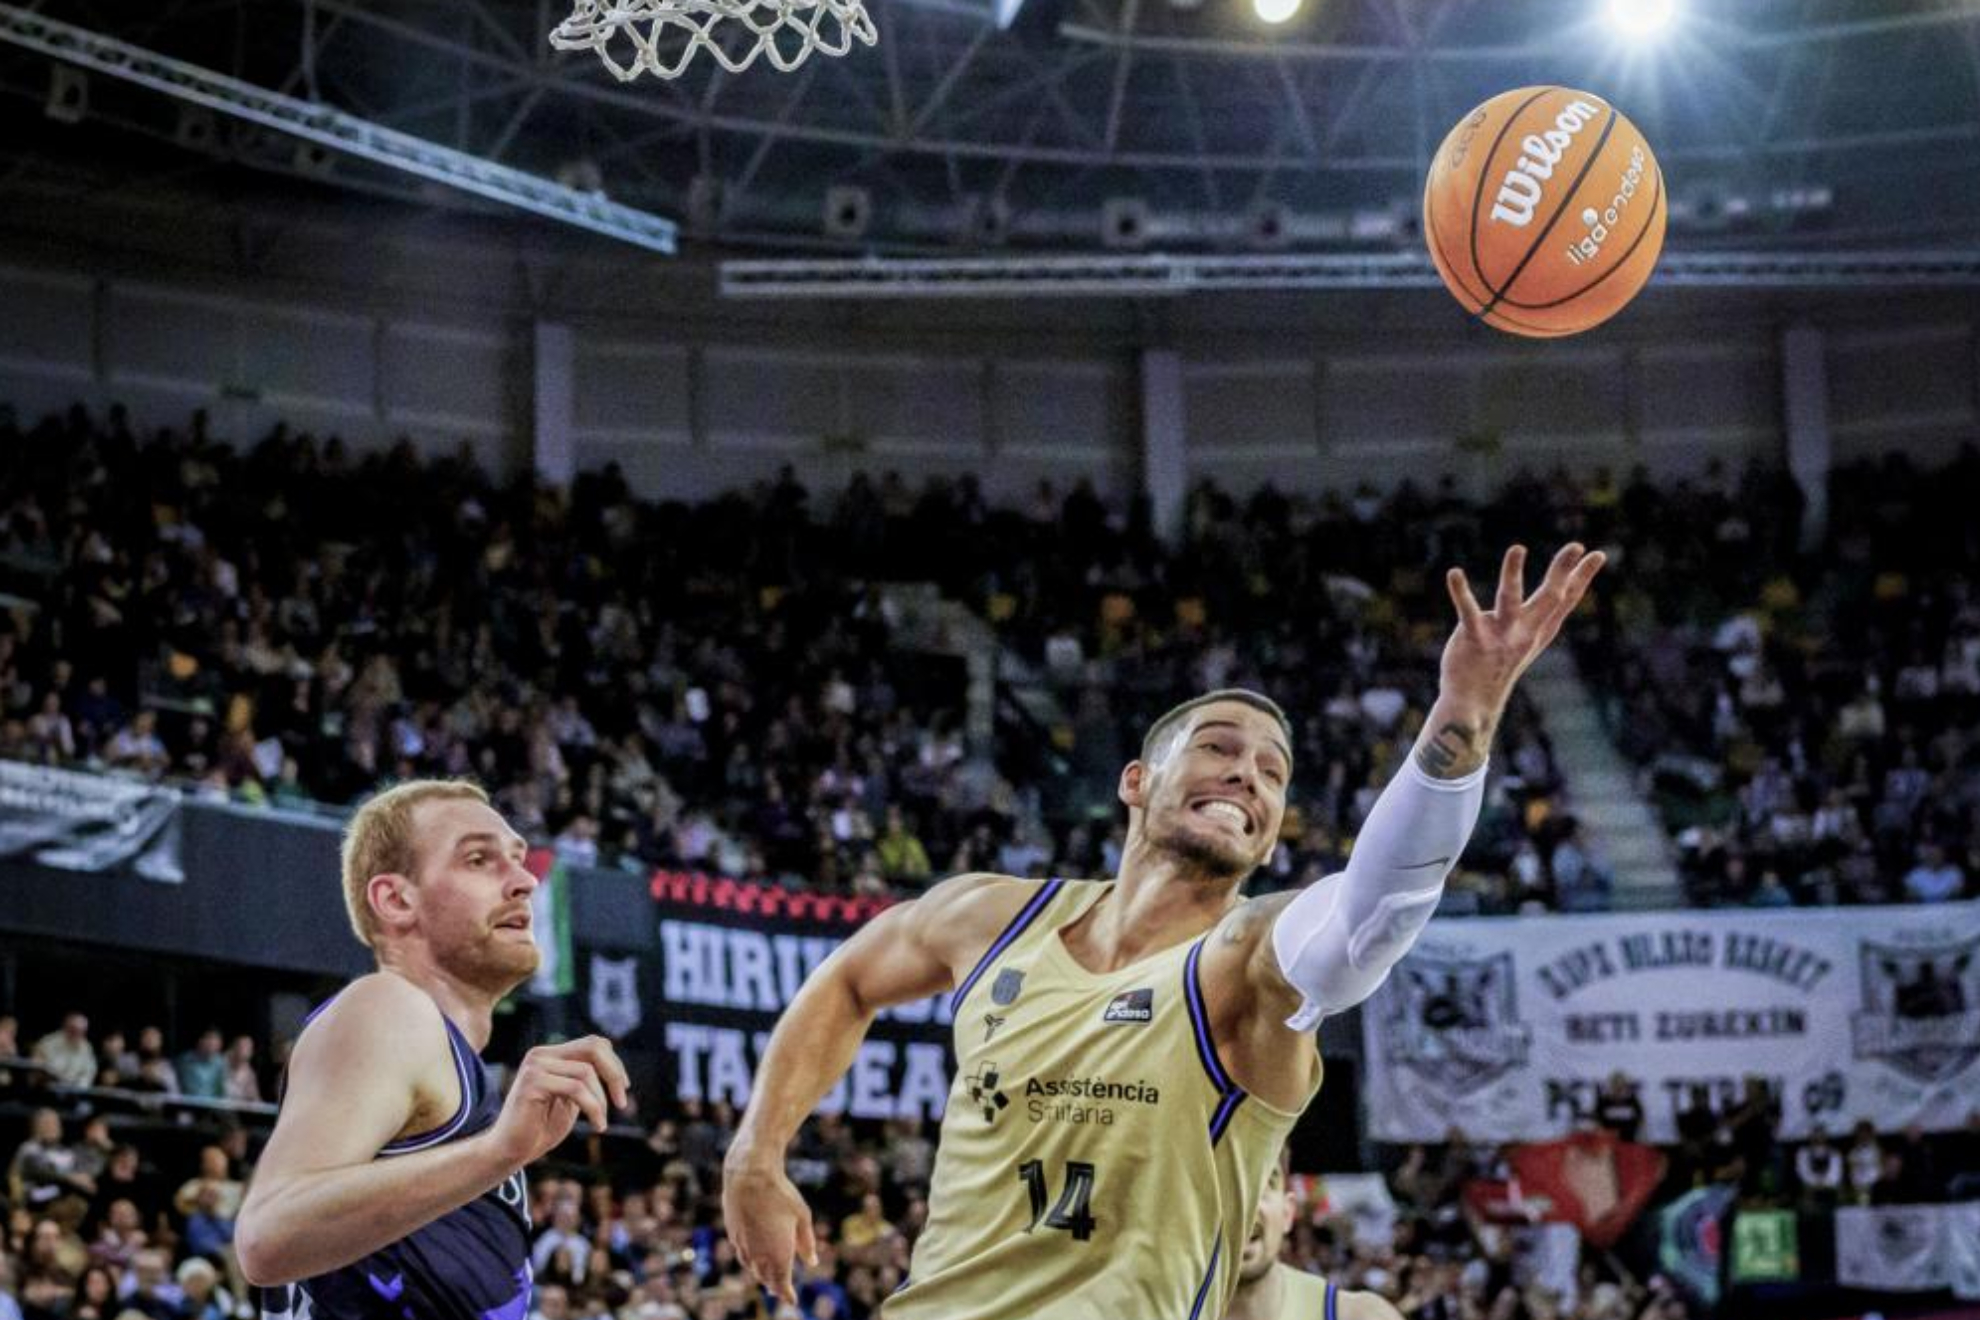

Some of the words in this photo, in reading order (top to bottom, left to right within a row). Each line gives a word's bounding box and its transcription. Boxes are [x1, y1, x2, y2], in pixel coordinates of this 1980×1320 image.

[1490, 99, 1599, 226] Wilson
[664, 1021, 950, 1122] TAEA
[1025, 1075, 1160, 1105] Assistència
[1018, 1158, 1096, 1242] 14
